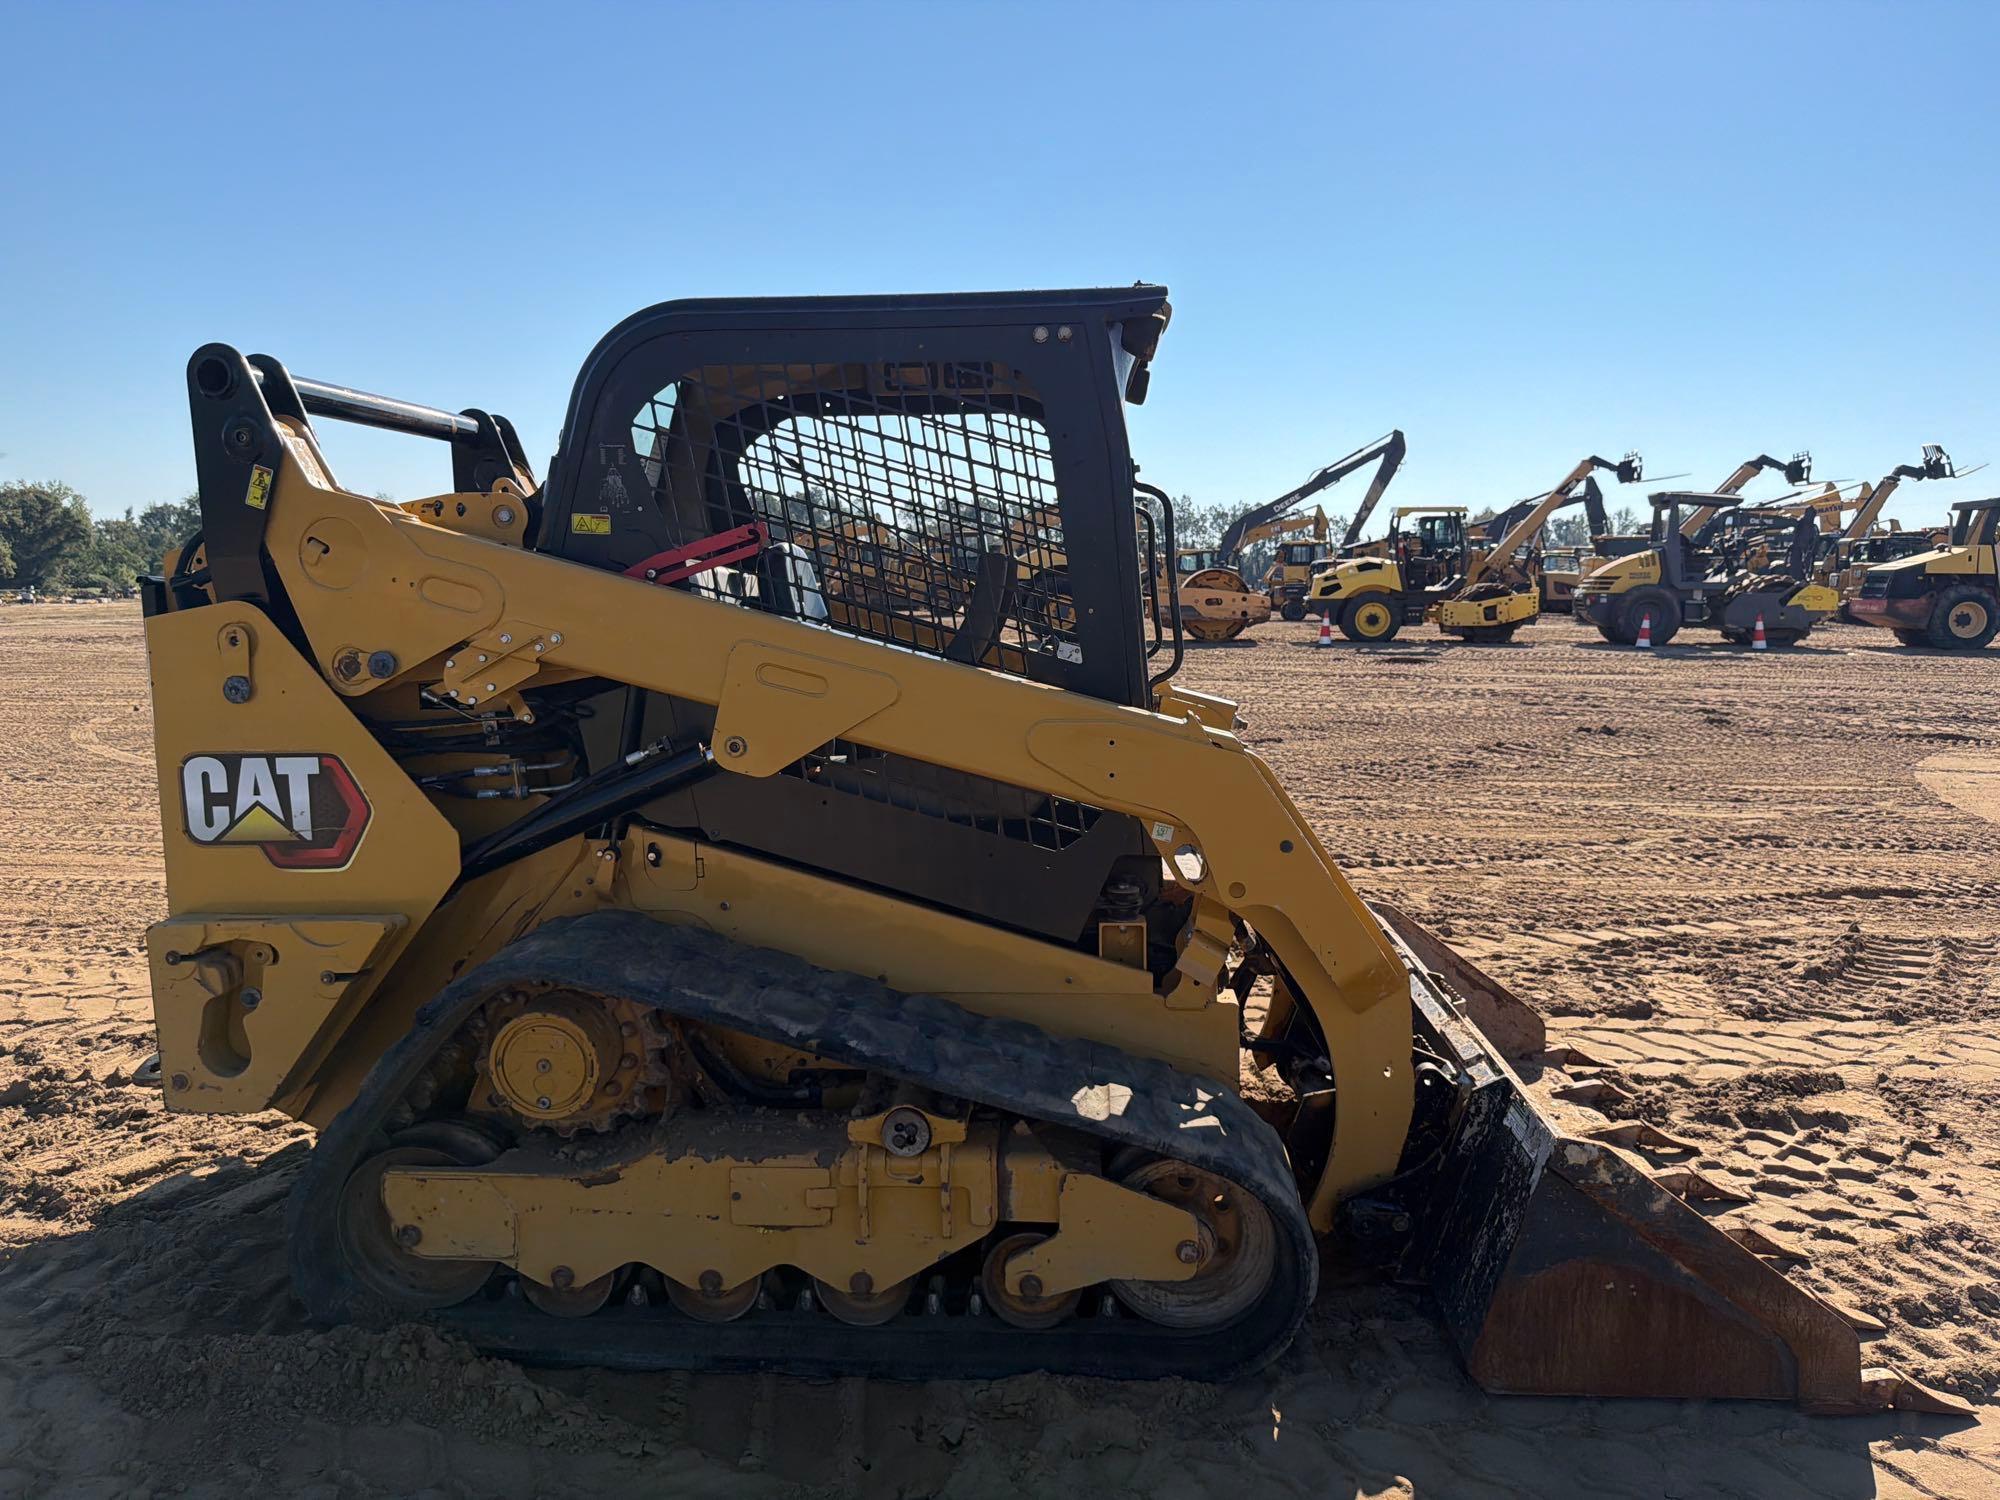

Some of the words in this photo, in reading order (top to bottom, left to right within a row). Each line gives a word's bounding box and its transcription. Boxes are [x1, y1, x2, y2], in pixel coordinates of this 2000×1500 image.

[1273, 493, 1301, 513] DEERE
[1750, 517, 1774, 525] DERE
[184, 757, 320, 841] CAT
